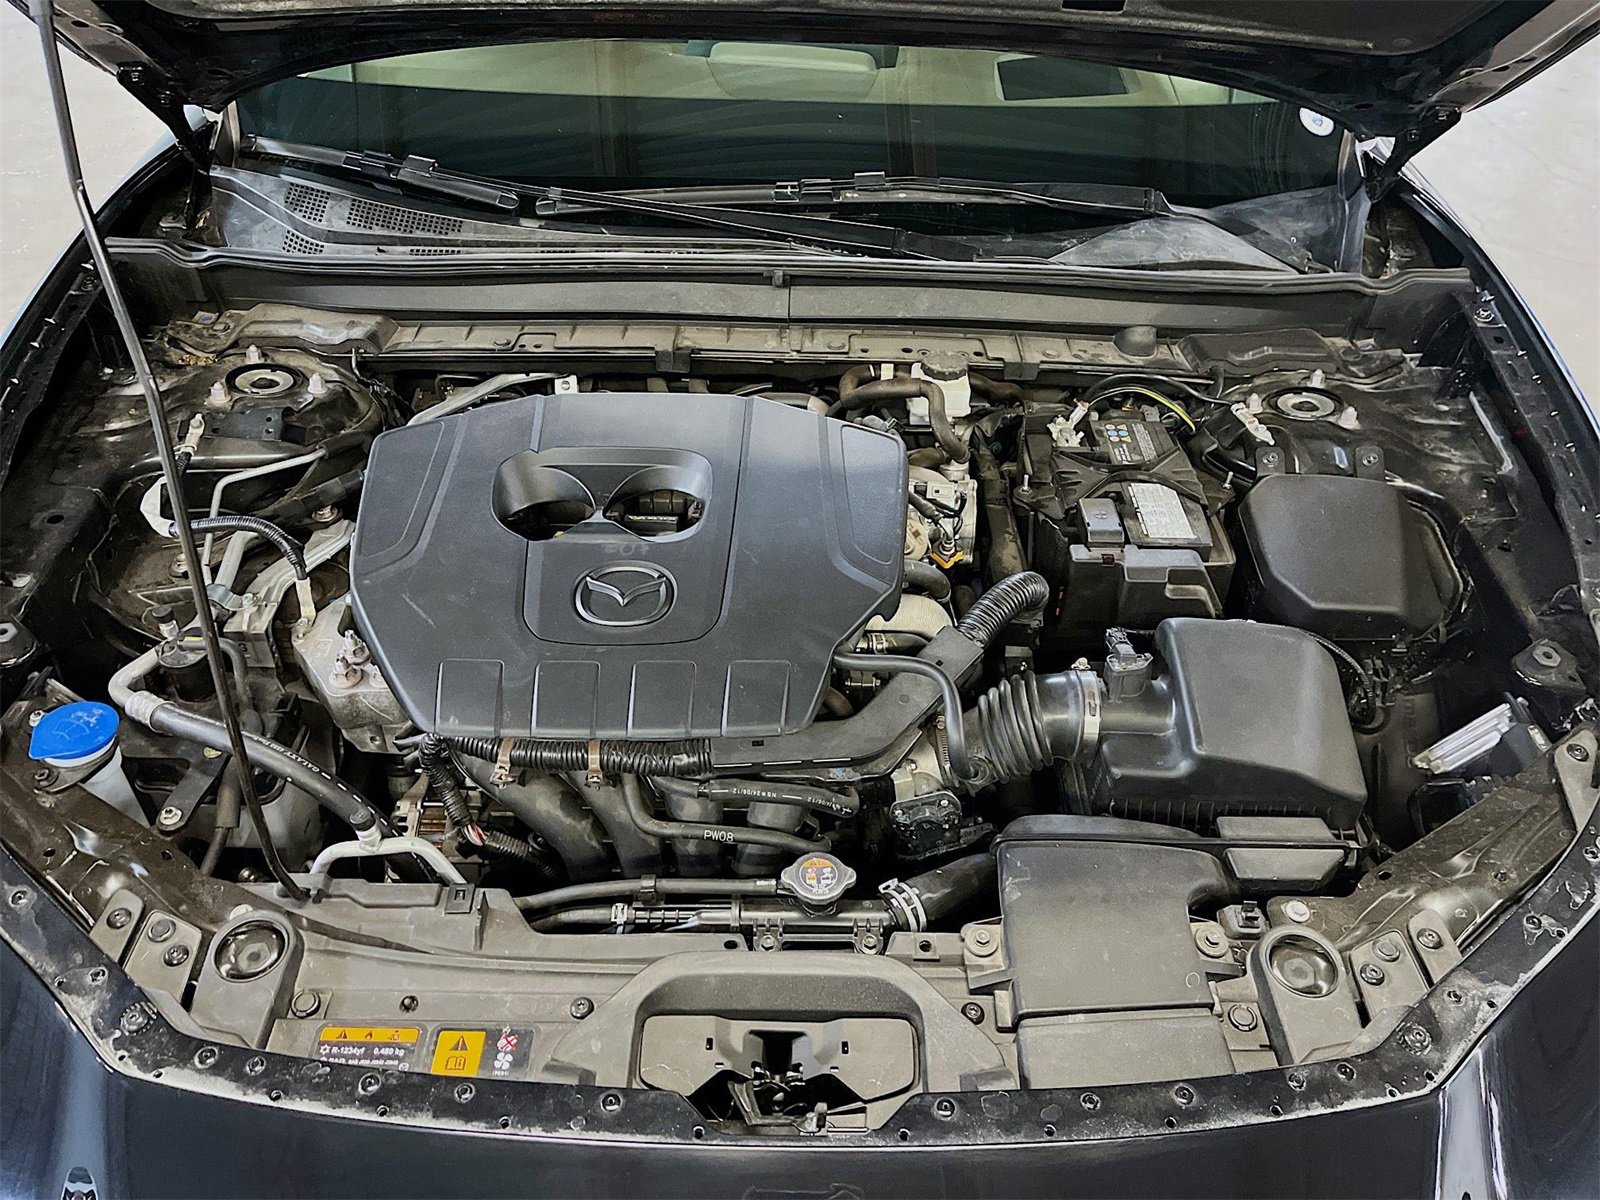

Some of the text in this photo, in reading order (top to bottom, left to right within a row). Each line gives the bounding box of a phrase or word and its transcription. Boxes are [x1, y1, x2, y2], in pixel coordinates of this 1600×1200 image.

[283, 751, 320, 772] GALAXY
[704, 830, 734, 842] PW08
[331, 1046, 366, 1056] R-1234yf
